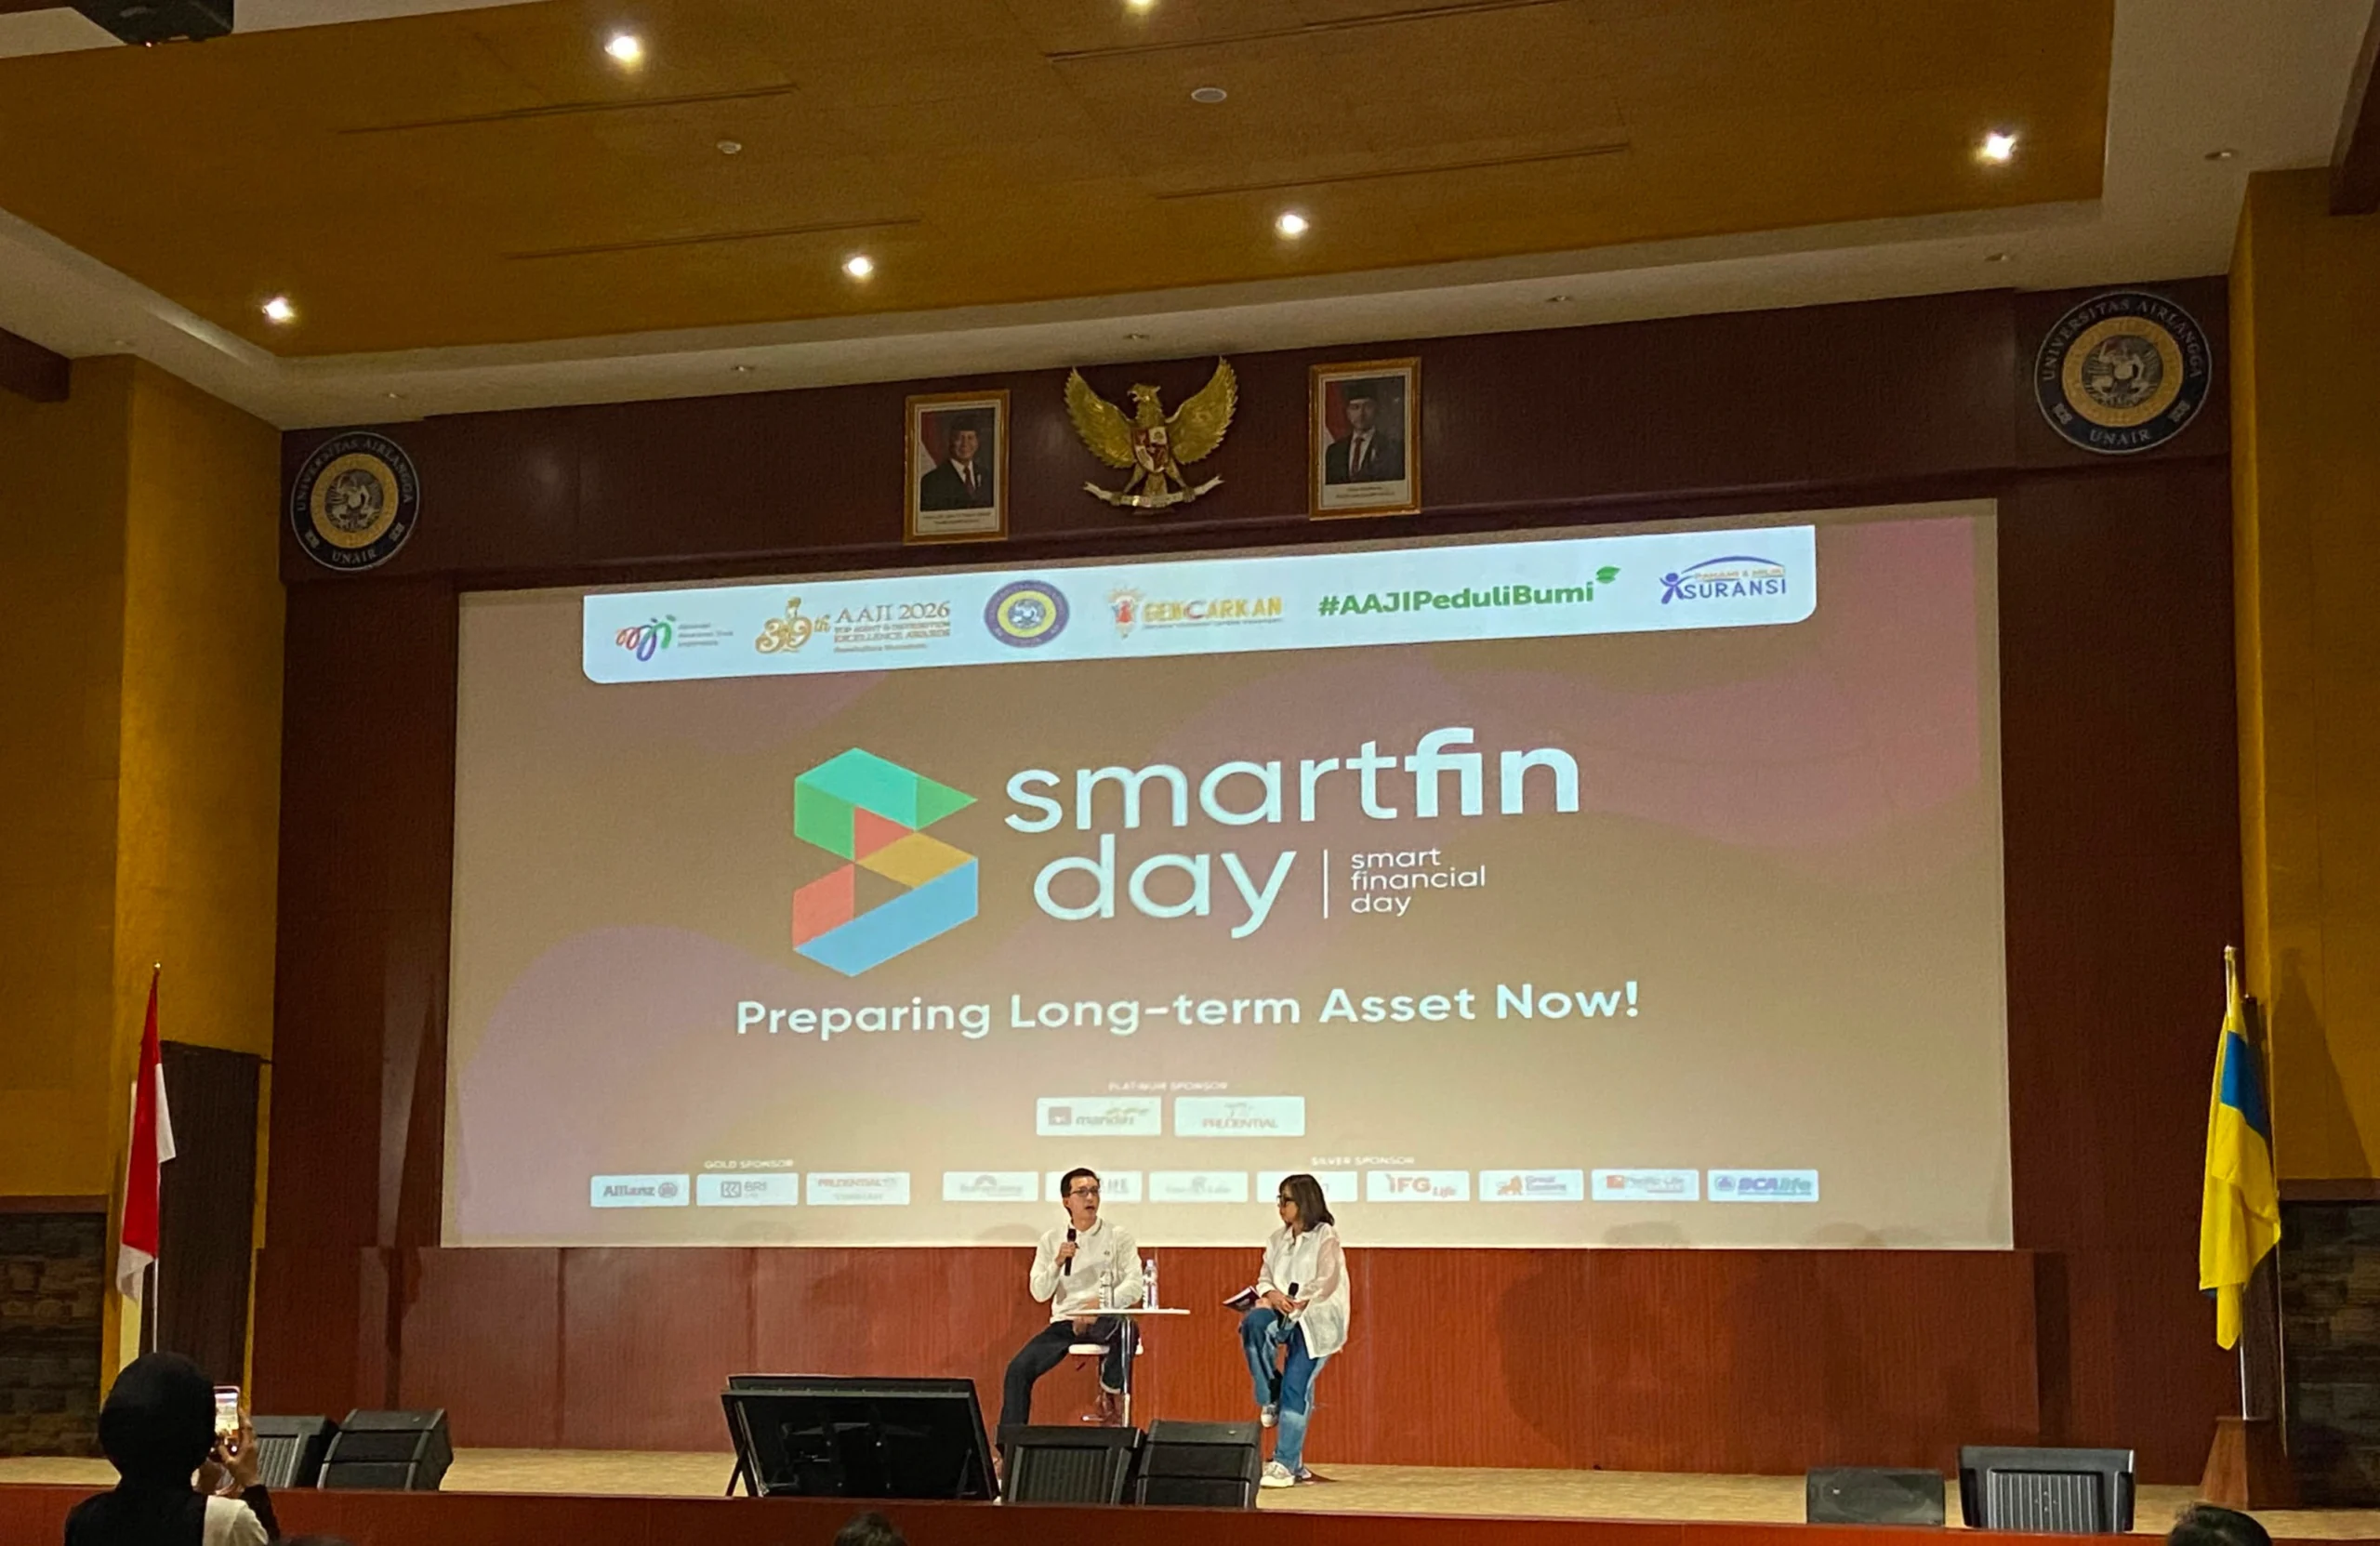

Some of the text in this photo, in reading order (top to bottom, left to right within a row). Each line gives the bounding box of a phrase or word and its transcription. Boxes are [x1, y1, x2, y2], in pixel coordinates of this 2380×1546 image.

[2043, 297, 2203, 382] UNIVERSITAS AIRLANGGA
[2089, 429, 2151, 446] UNAIR
[331, 548, 377, 565] UNAIR
[1317, 581, 1594, 616] #AAJIPeduliBumi
[836, 601, 951, 624] AAJI 2026
[1004, 727, 1580, 833] smartfin
[1351, 847, 1442, 869] smart
[1033, 833, 1298, 940] day
[1351, 865, 1486, 891] financial
[1351, 892, 1411, 917] day
[736, 980, 1640, 1041] Preparing Long-term Asset Now!
[1170, 1081, 1229, 1091] SPONSOR
[704, 1160, 738, 1169] GOLD
[1312, 1156, 1415, 1166] SILVER SPONSOR
[603, 1184, 655, 1197] Allianz
[1385, 1174, 1432, 1194] IFG
